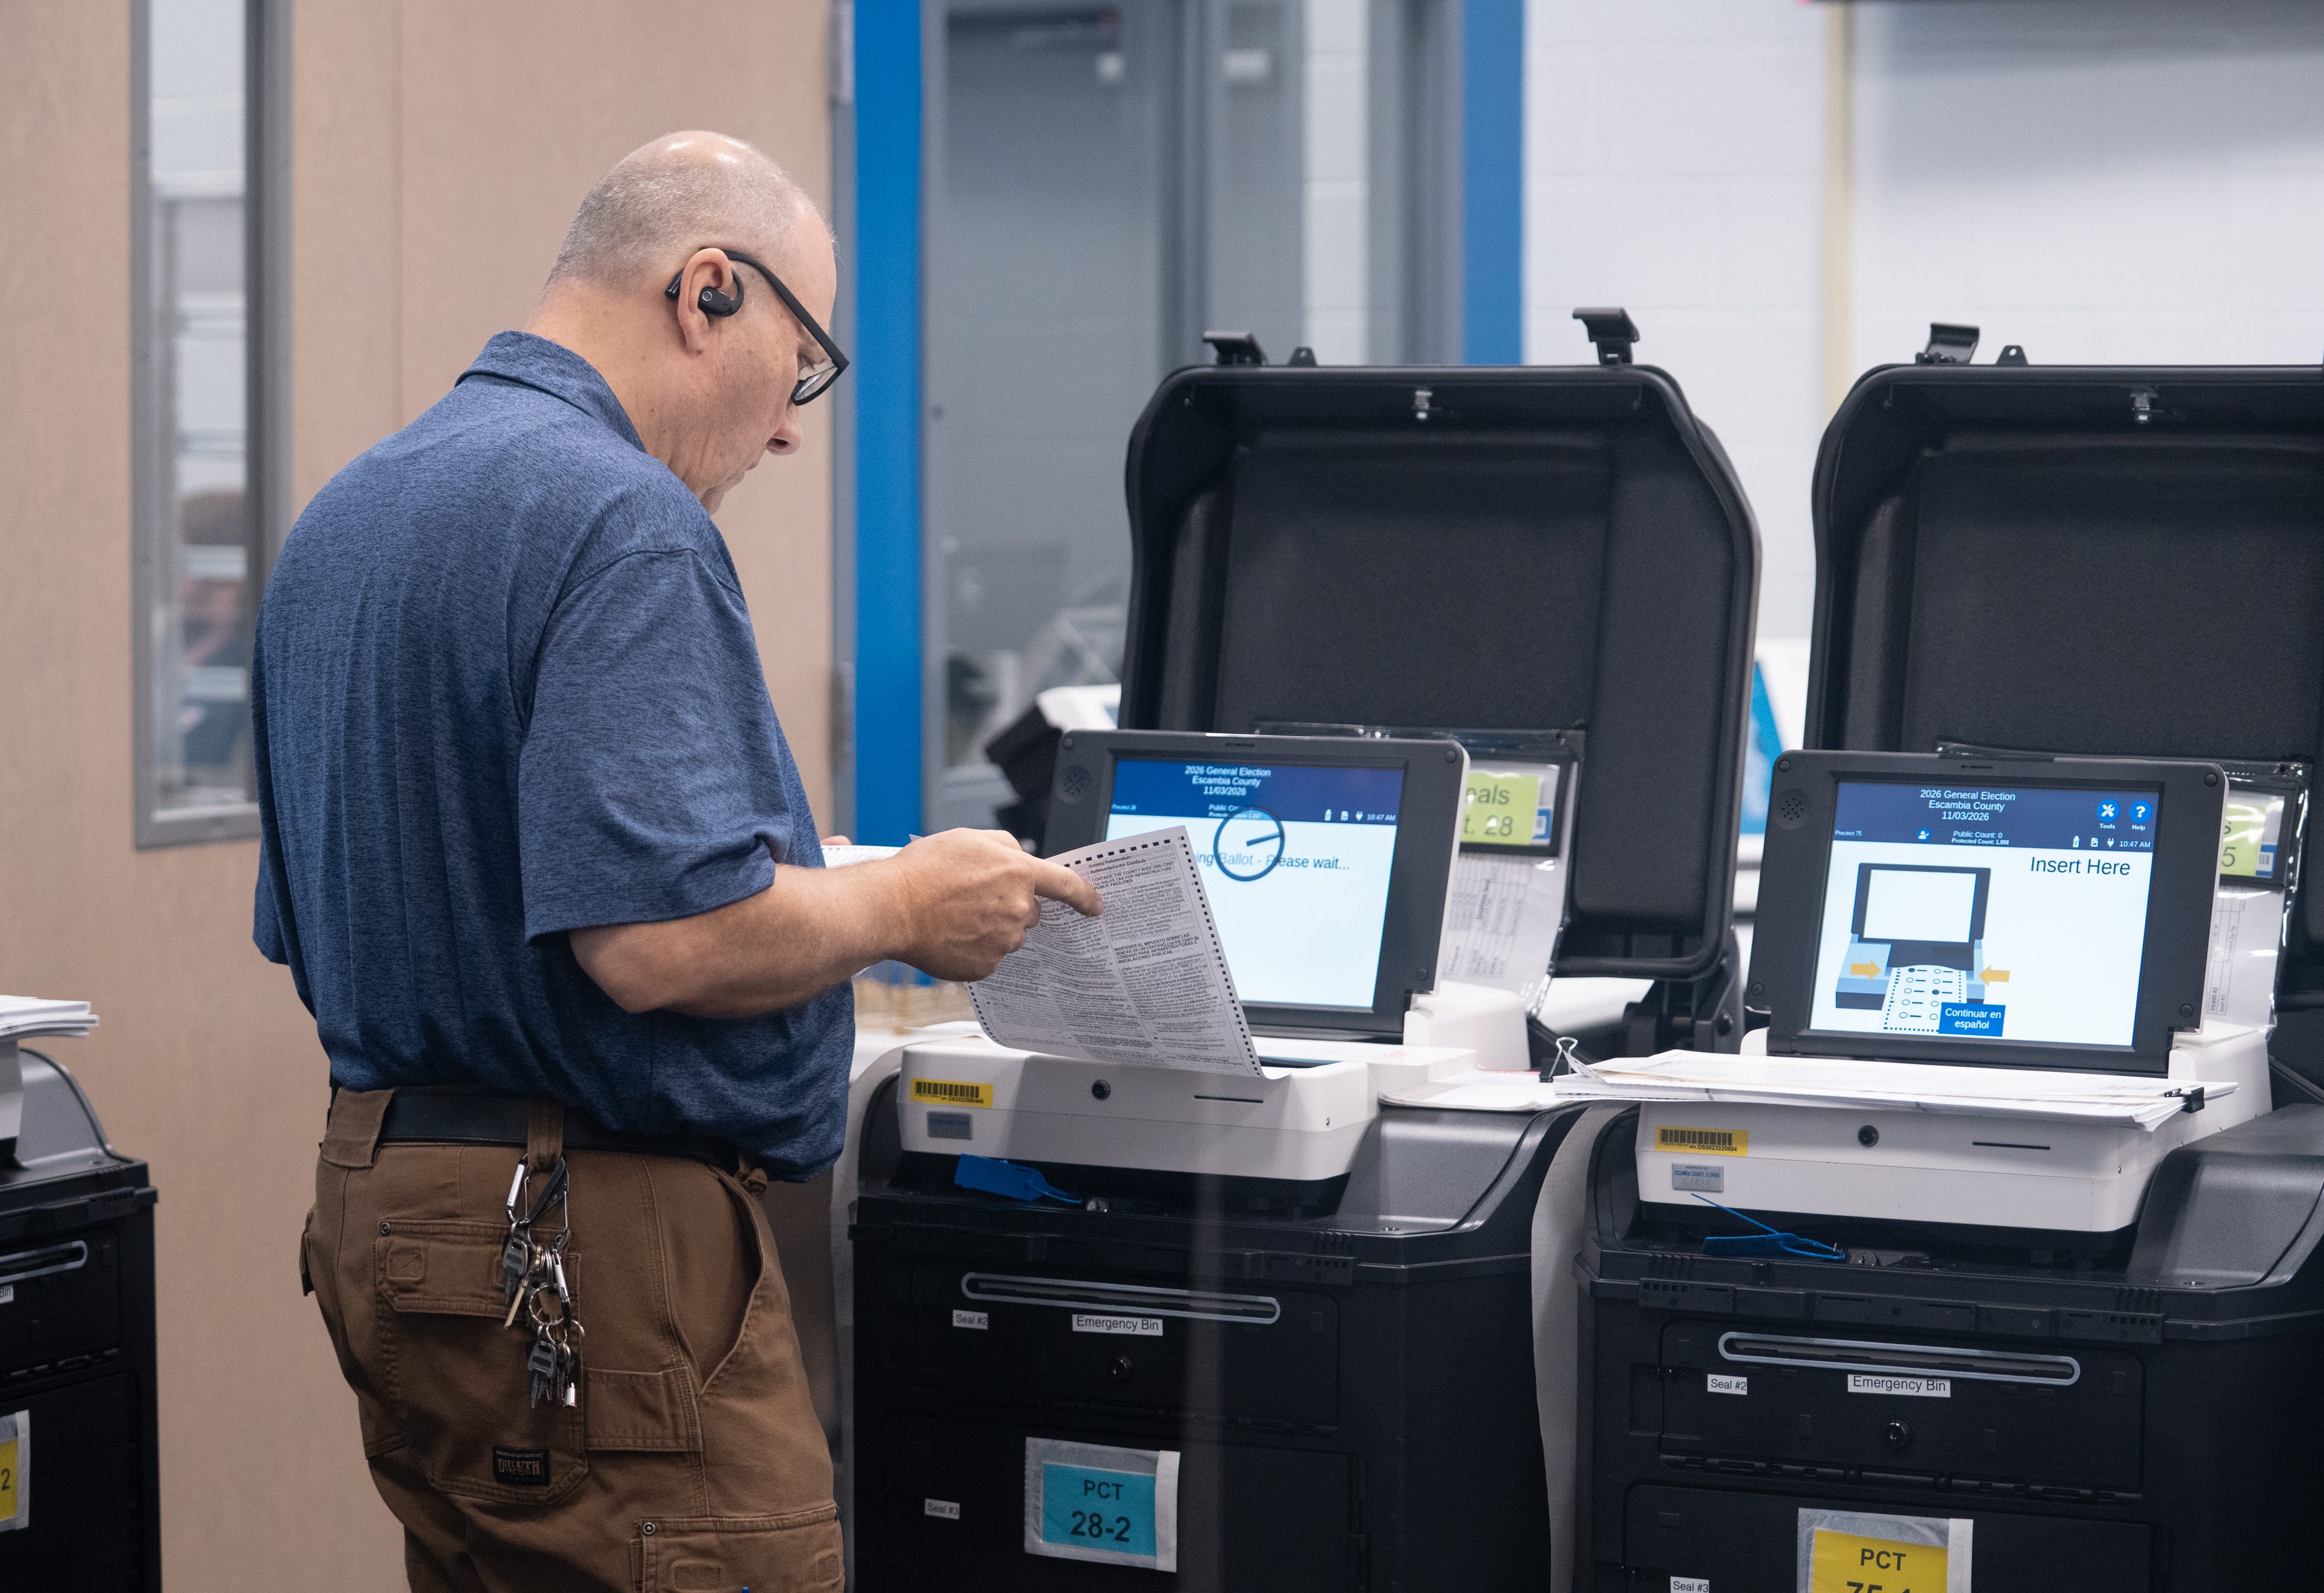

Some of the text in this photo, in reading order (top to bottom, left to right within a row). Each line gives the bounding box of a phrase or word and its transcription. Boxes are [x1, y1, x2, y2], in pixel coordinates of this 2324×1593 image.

[1185, 765, 1271, 776] 2026 General Election
[1192, 775, 1261, 788] Escambia County
[1204, 786, 1246, 796] 11/03/2026
[1466, 785, 1509, 804] eals
[1920, 789, 2016, 800] 2026 General Election
[1929, 800, 2004, 812] Escambia County
[1942, 811, 1989, 821] 11/03/2026
[1484, 815, 1513, 836] 28
[1218, 852, 1253, 865] Ballot
[1313, 857, 1350, 869] wait...
[2221, 846, 2236, 867] 5
[1135, 867, 1172, 877] INFRASTRUCTURE
[2031, 857, 2131, 875] Insert Here
[1092, 874, 1113, 882] CONTINUE
[1123, 866, 1152, 875] COUNTY-WIDE
[1151, 940, 1193, 953] INFRAESTRUCTURAS
[1118, 954, 1151, 964] INSTALACIONES
[1945, 1008, 1988, 1018] Continuar
[1954, 1020, 1989, 1030] español
[956, 1313, 988, 1326] Seal #2
[1077, 1316, 1159, 1331] Emergency Bin
[1710, 1379, 1746, 1391] Seal #2
[1853, 1376, 1946, 1392] Emergency Bin
[498, 1458, 540, 1474] DULUTH
[1084, 1480, 1124, 1501] PCT
[928, 1503, 946, 1513] Seal
[1070, 1511, 1131, 1542] 28-2
[1860, 1548, 1906, 1571] PCT
[1673, 1581, 1709, 1592] Seal #3
